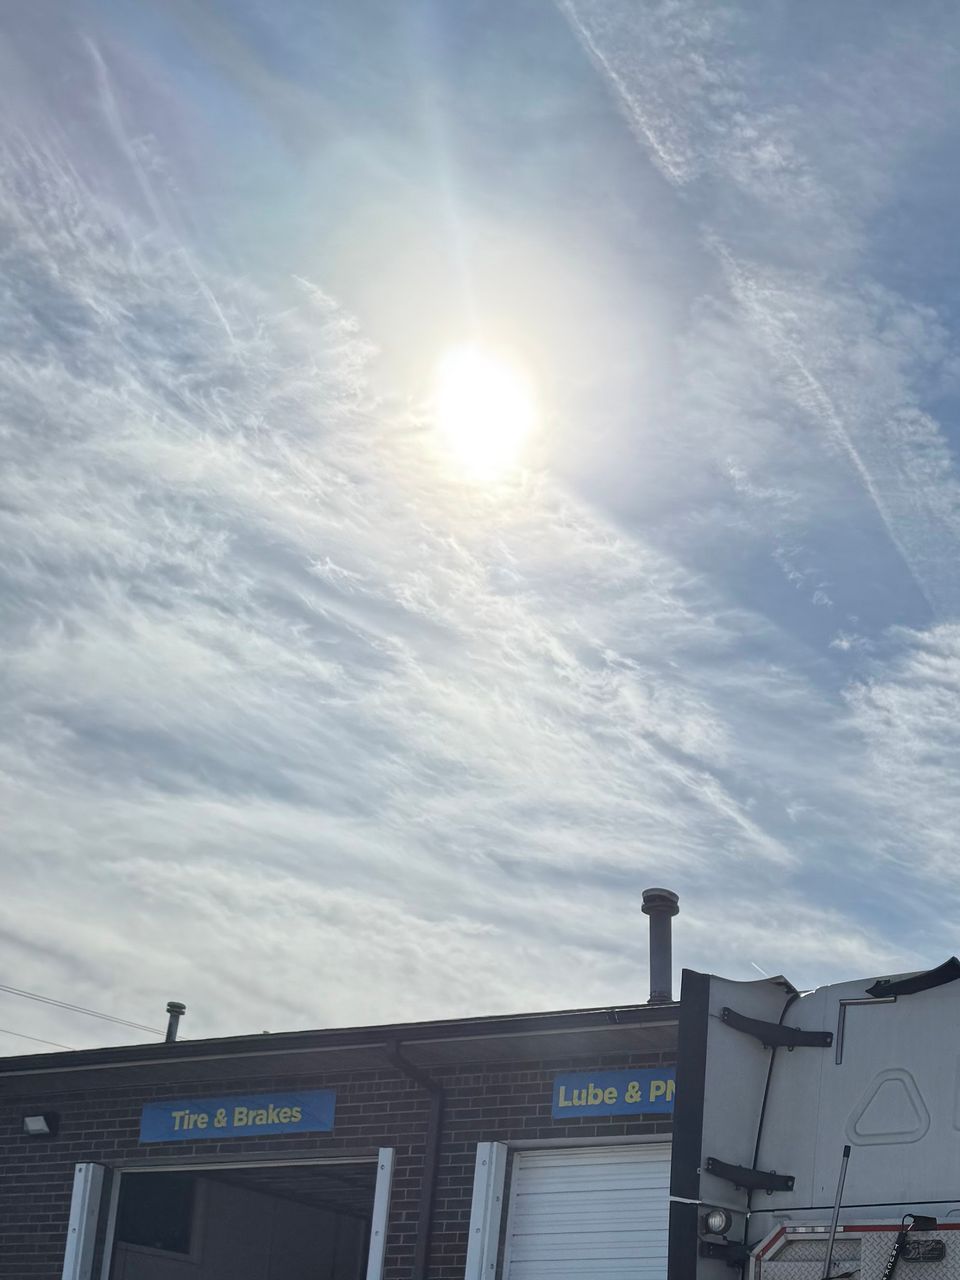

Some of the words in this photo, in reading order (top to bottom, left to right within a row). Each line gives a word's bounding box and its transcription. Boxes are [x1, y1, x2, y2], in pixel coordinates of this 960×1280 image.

[559, 1082, 618, 1107] Lube
[624, 1081, 642, 1104] &
[171, 1109, 208, 1131] Tire
[213, 1108, 228, 1128] &
[233, 1104, 303, 1127] Brakes
